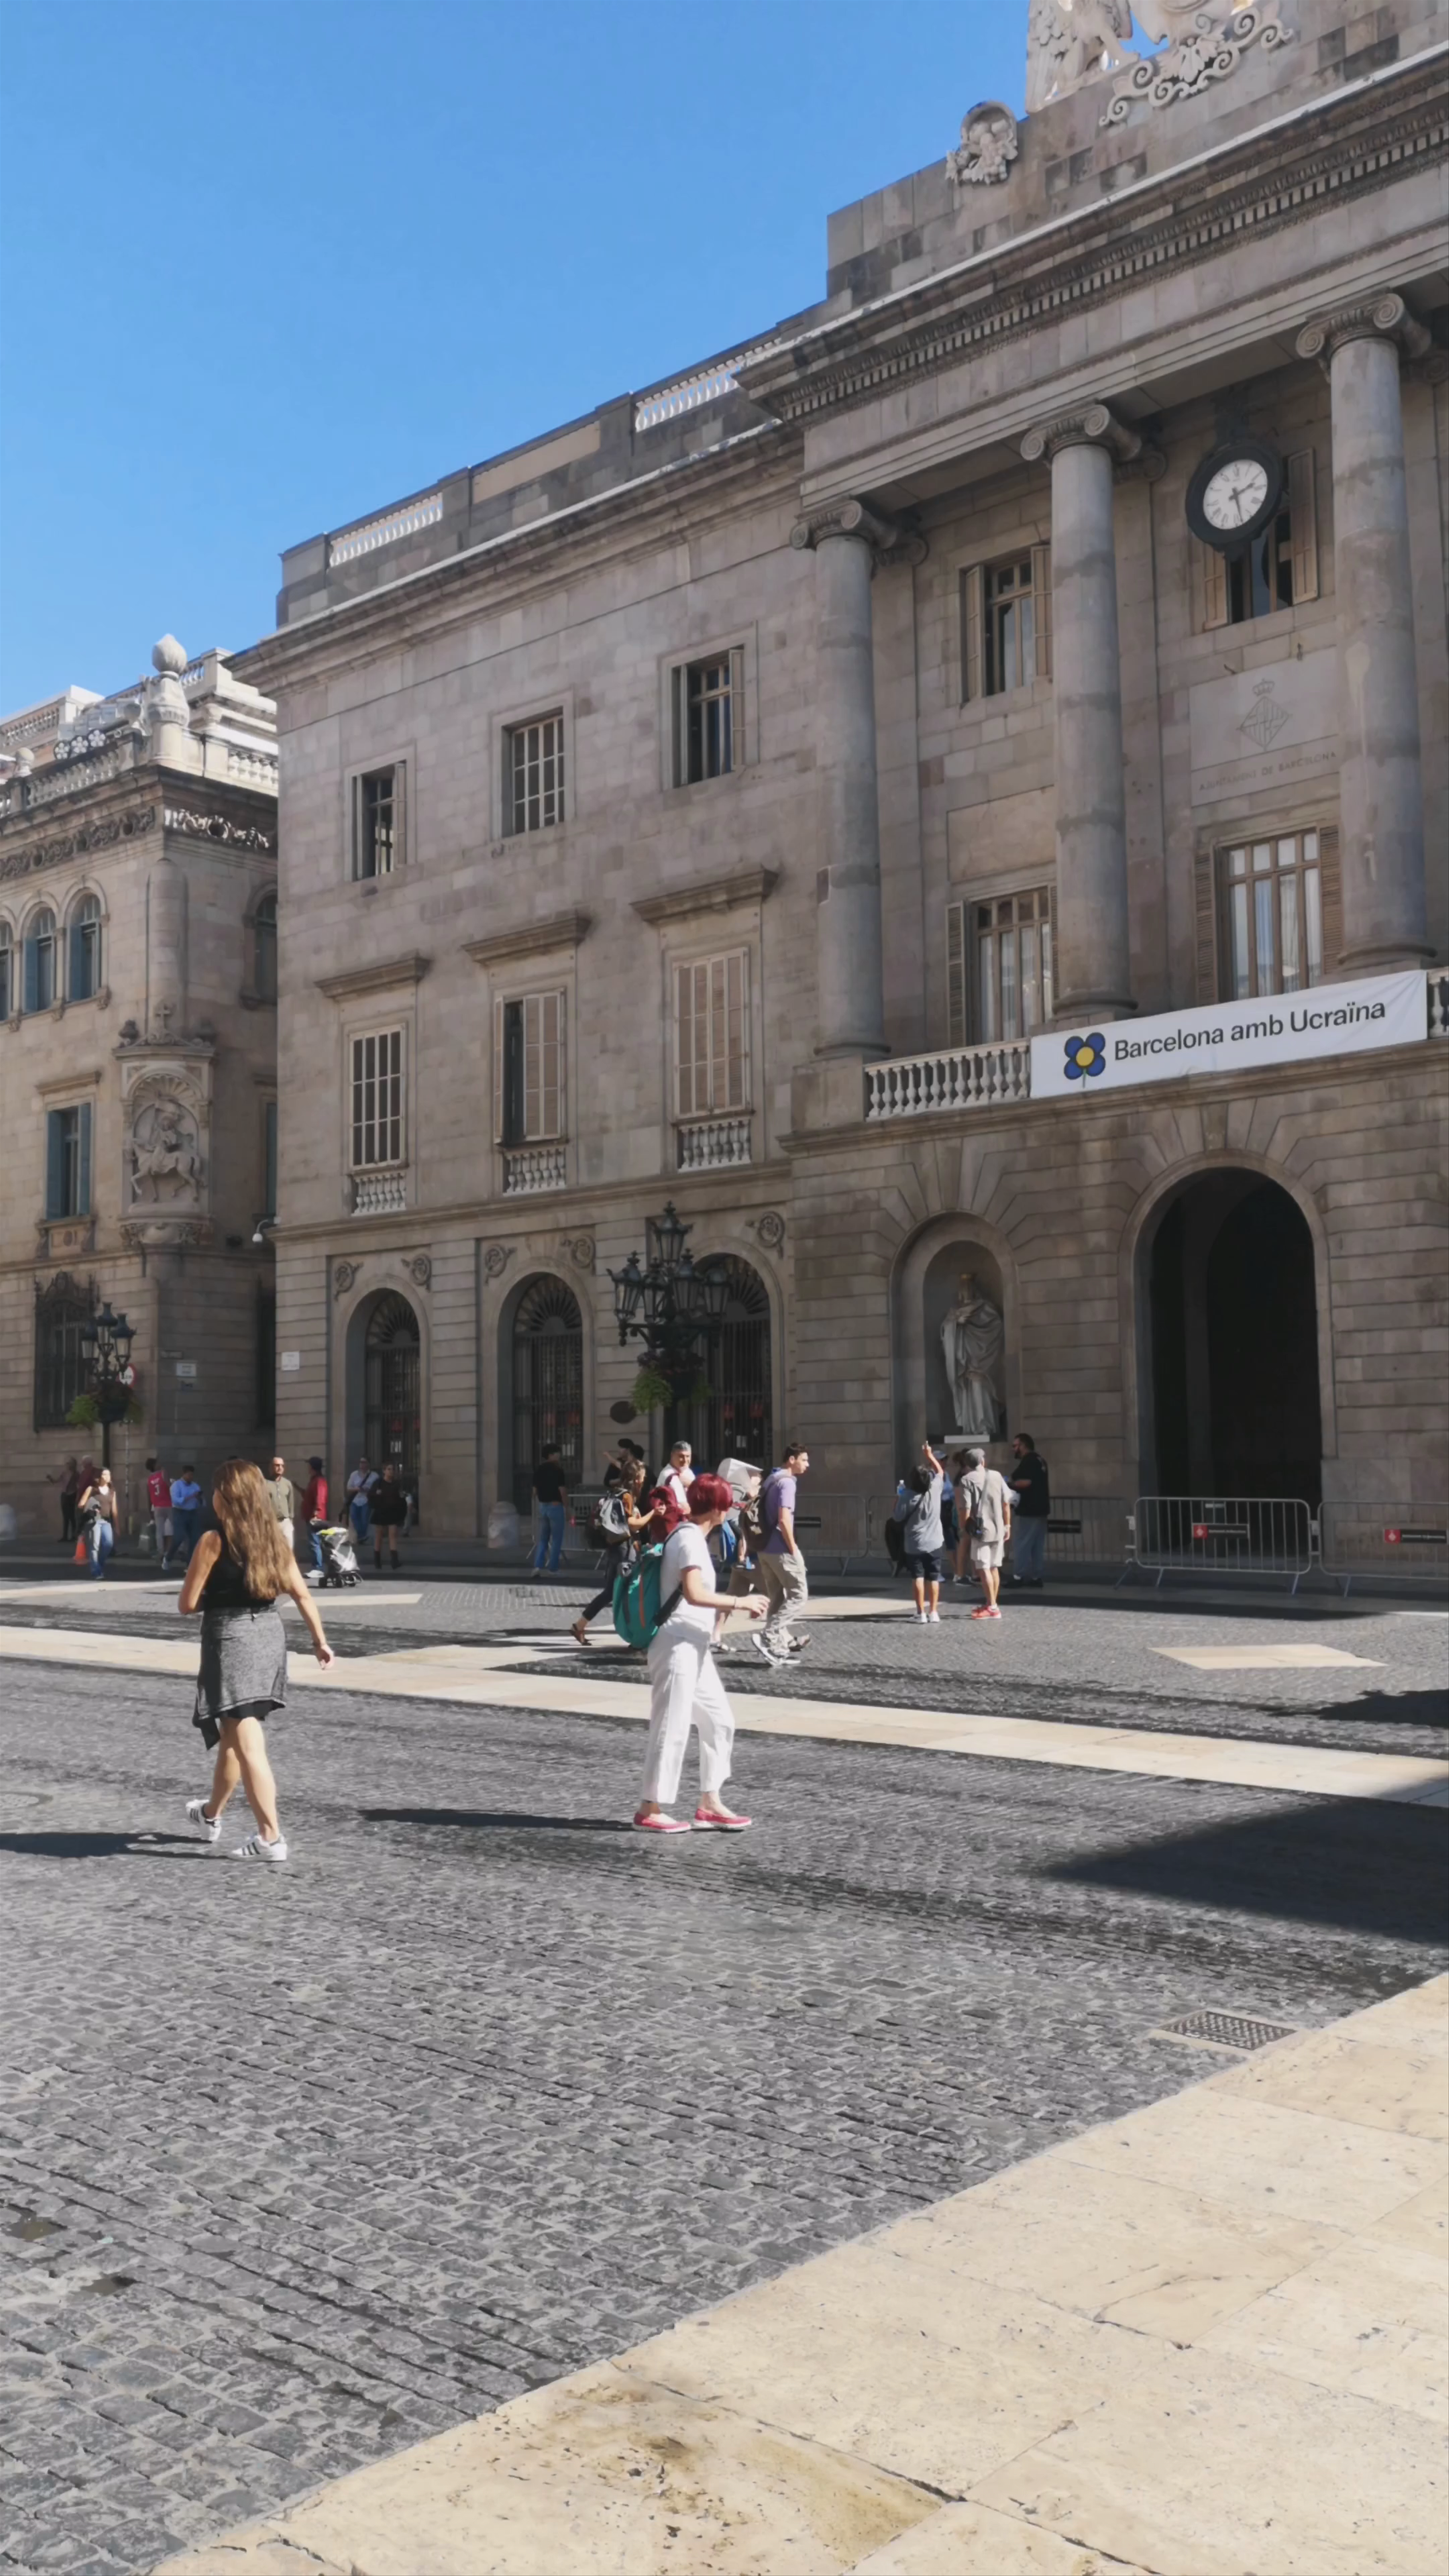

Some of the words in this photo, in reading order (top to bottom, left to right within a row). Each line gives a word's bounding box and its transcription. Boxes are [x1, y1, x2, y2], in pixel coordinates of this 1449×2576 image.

[1261, 766, 1274, 776] DE
[1278, 751, 1337, 772] BARCELONA
[1115, 1028, 1224, 1061] Barcelona
[1231, 1014, 1284, 1041] amb
[1290, 1001, 1386, 1032] Ucraïna
